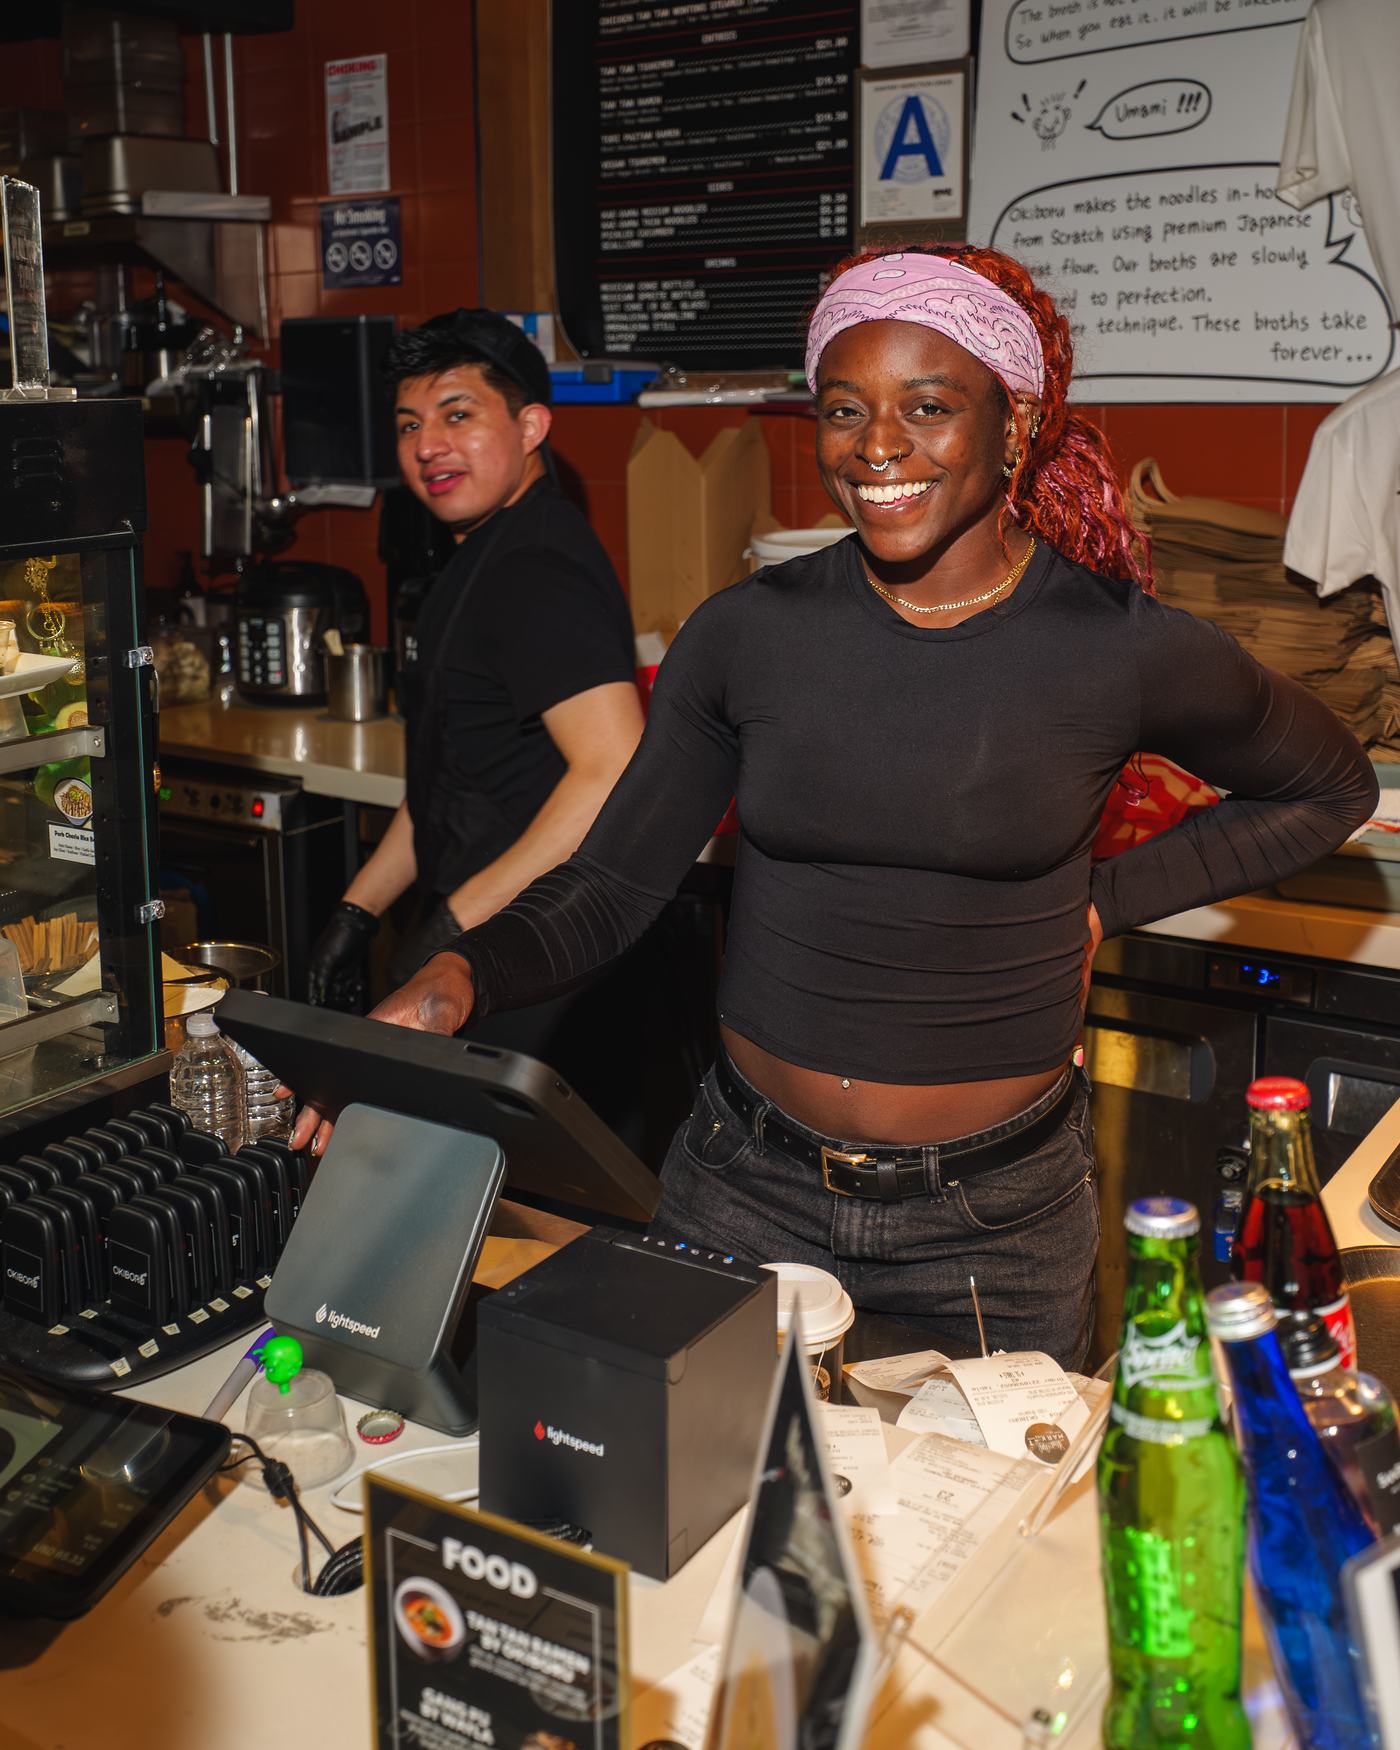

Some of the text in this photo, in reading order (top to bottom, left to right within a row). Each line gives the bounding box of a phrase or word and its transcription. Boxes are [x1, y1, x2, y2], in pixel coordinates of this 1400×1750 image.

[1016, 33, 1032, 50] So
[1041, 29, 1071, 43] when
[1078, 22, 1101, 41] you
[1110, 15, 1133, 29] eat
[1115, 98, 1168, 122] Umami
[879, 95, 945, 181] A
[1073, 196, 1117, 214] makes
[1126, 192, 1151, 210] the
[1158, 183, 1218, 206] noodles
[1013, 231, 1043, 248] from
[1112, 224, 1152, 243] using
[1163, 219, 1227, 243] premium
[1237, 213, 1312, 237] Japanese
[1113, 254, 1139, 272] Our
[1150, 251, 1197, 272] broths
[1210, 250, 1238, 267] are
[1252, 245, 1309, 270] slowly
[1090, 290, 1108, 306] to
[1117, 286, 1212, 311] perfection.
[1097, 315, 1184, 339] technique.
[1192, 312, 1241, 333] These
[1254, 309, 1310, 332] broths
[1320, 310, 1367, 331] take
[327, 1309, 381, 1339] lightspeed
[547, 1425, 604, 1457] lightspeed
[442, 1536, 537, 1599] FOOD
